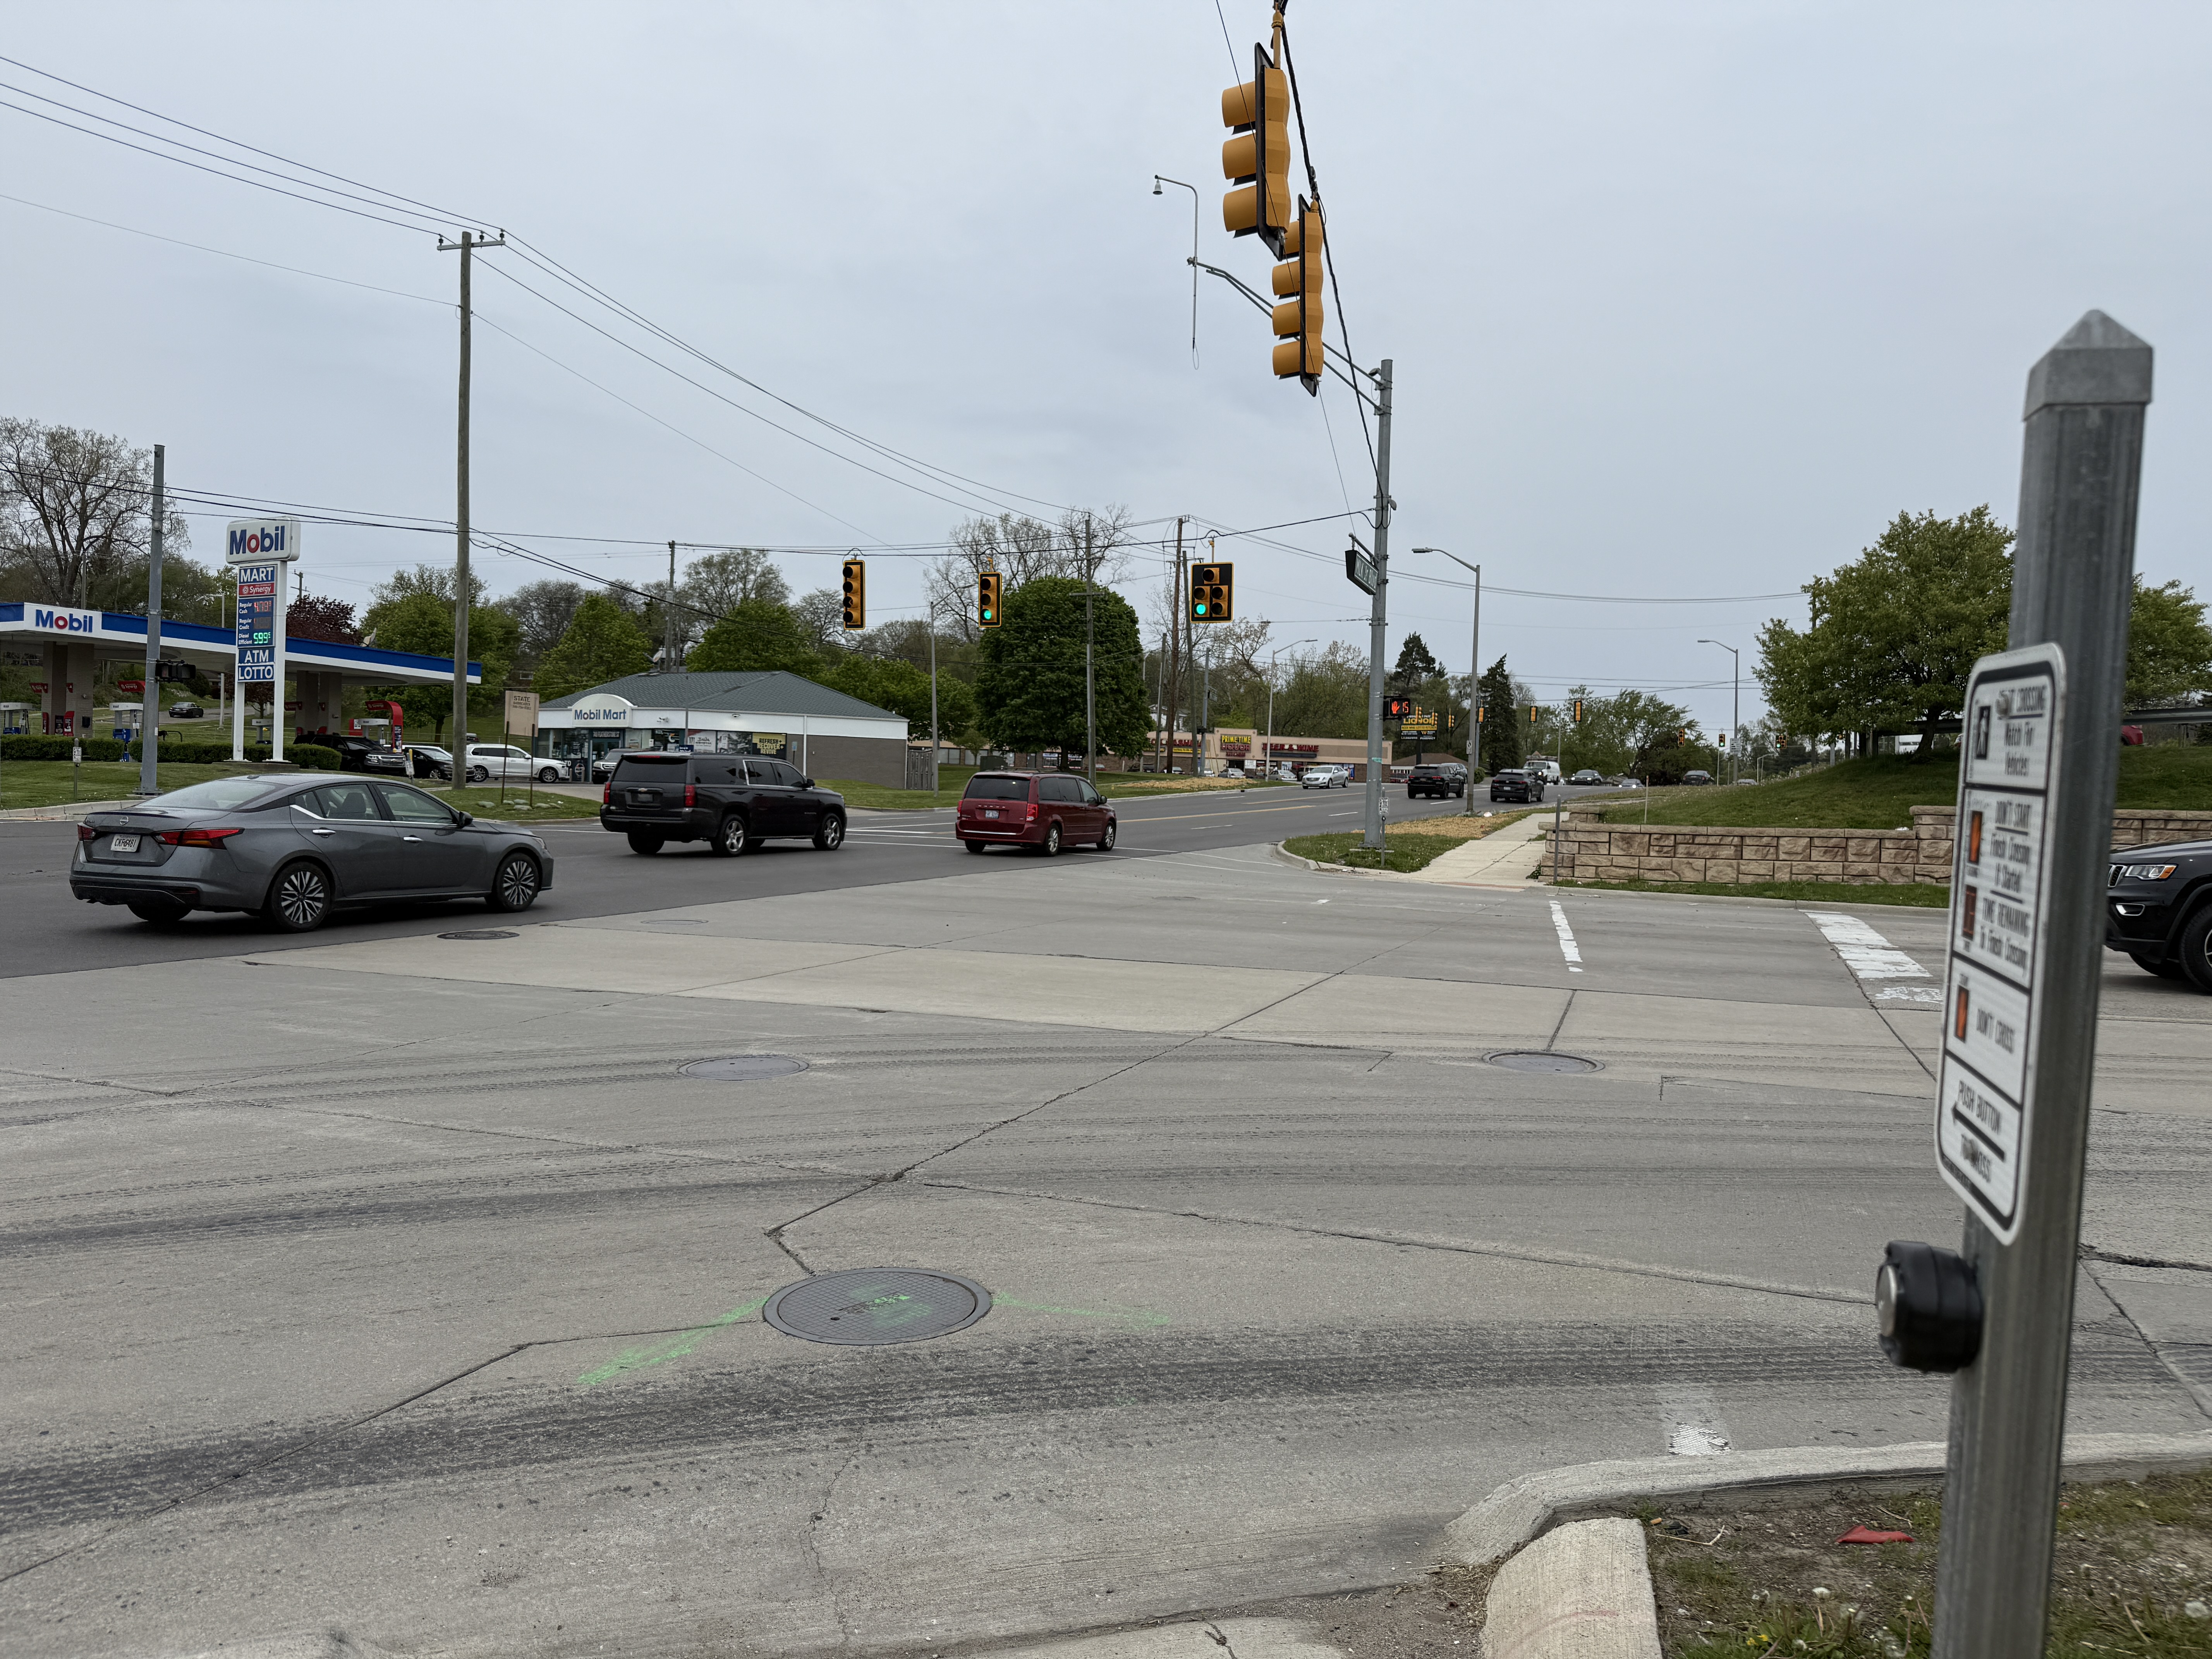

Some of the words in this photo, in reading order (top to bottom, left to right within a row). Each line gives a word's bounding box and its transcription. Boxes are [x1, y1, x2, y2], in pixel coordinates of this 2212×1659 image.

[230, 526, 285, 555] Mobil
[240, 568, 273, 582] MART
[1356, 558, 1364, 578] MLK
[1369, 569, 1377, 589] Blvd
[35, 609, 93, 632] Mobil
[245, 650, 269, 663] ATM
[239, 666, 273, 679] LOTTO
[1403, 701, 1408, 713] 15
[2016, 685, 2045, 712] CROSSING
[574, 709, 600, 720] Mobil
[603, 709, 626, 720] Mart
[2004, 723, 2021, 746] Watch
[2024, 722, 2033, 746] For
[1996, 800, 2013, 826] DON'T
[2014, 803, 2031, 829] START
[1977, 1008, 1994, 1039] DON'T
[1995, 1020, 2014, 1054] CROSS
[1958, 1080, 1975, 1113] PUSH
[1975, 1095, 2001, 1135] BUTTON
